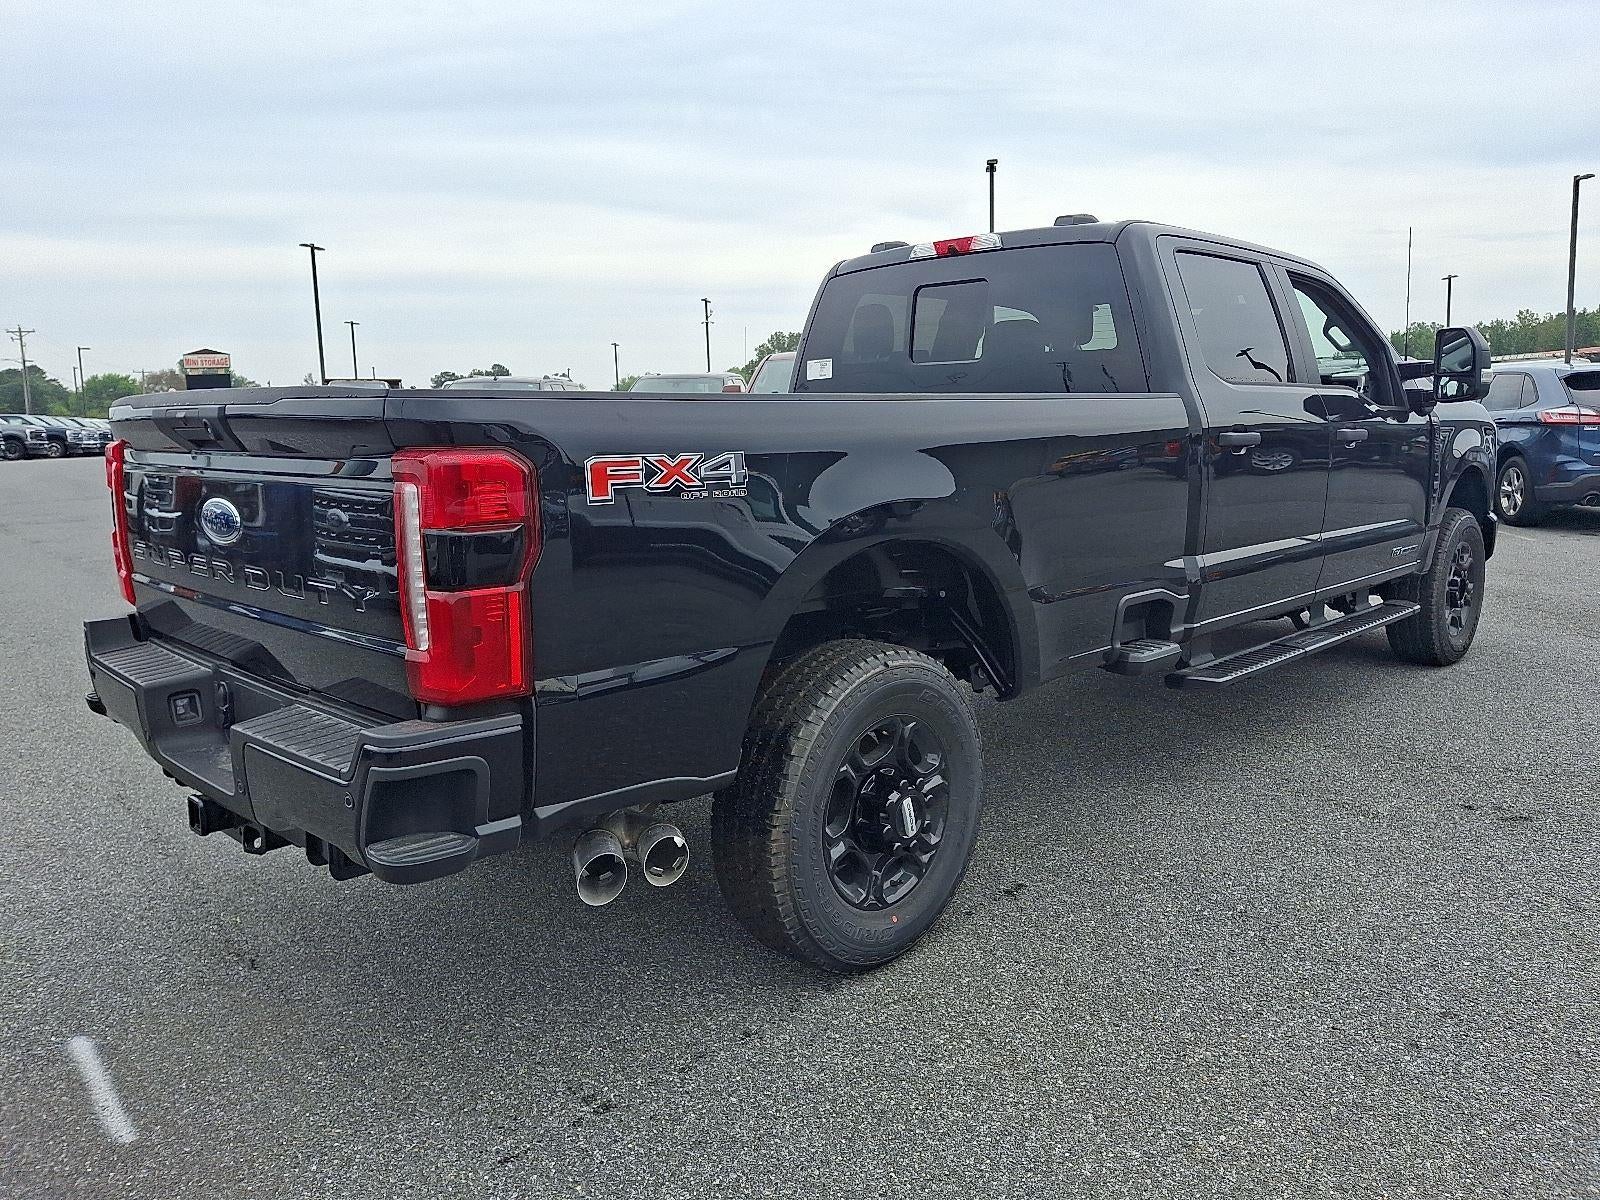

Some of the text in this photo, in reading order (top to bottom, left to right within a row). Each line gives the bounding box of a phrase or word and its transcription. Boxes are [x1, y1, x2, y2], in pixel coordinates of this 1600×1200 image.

[184, 357, 229, 366] MINI STORAGE
[584, 451, 748, 505] FX4
[680, 488, 748, 500] OFF ROAD
[133, 540, 381, 613] SUPER DUTY
